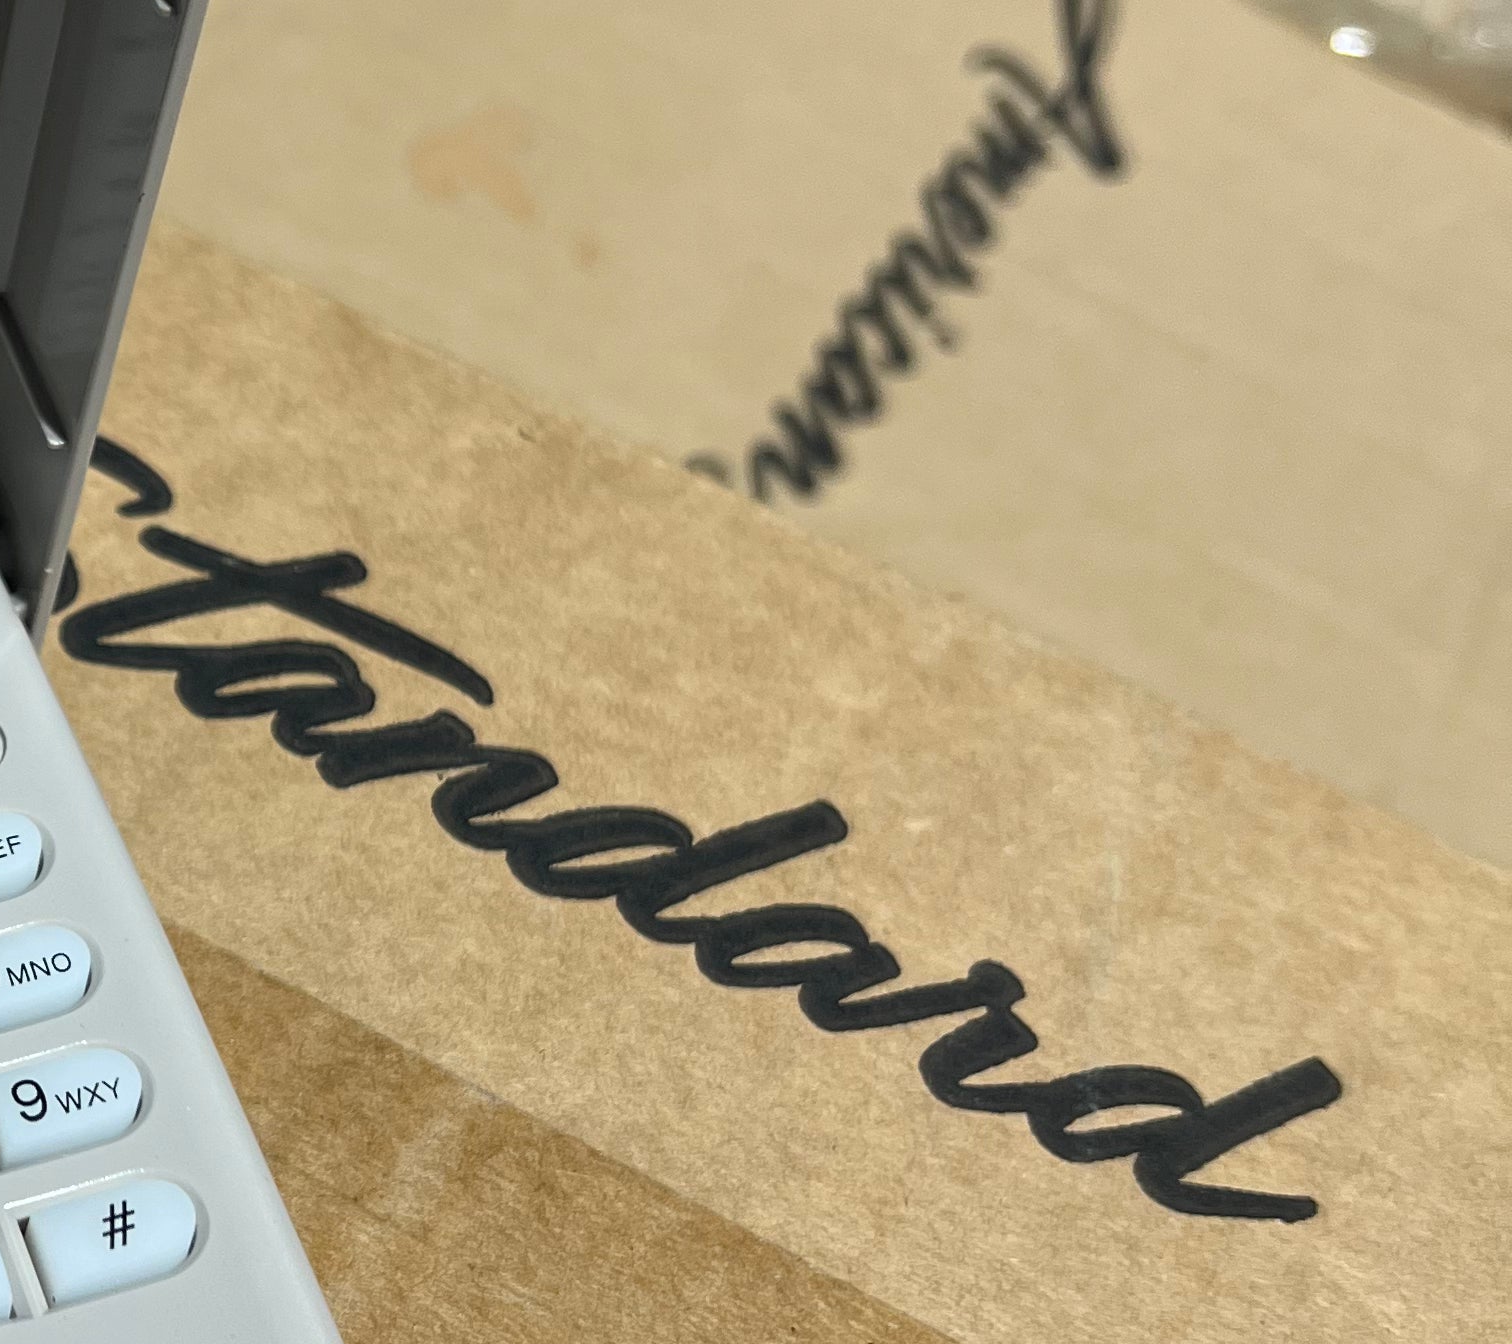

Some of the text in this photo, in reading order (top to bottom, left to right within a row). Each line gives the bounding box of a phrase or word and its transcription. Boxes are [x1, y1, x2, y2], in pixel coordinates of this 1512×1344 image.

[6, 953, 71, 986] MNO
[12, 1078, 118, 1121] 9 WXY
[103, 1201, 134, 1249] #
